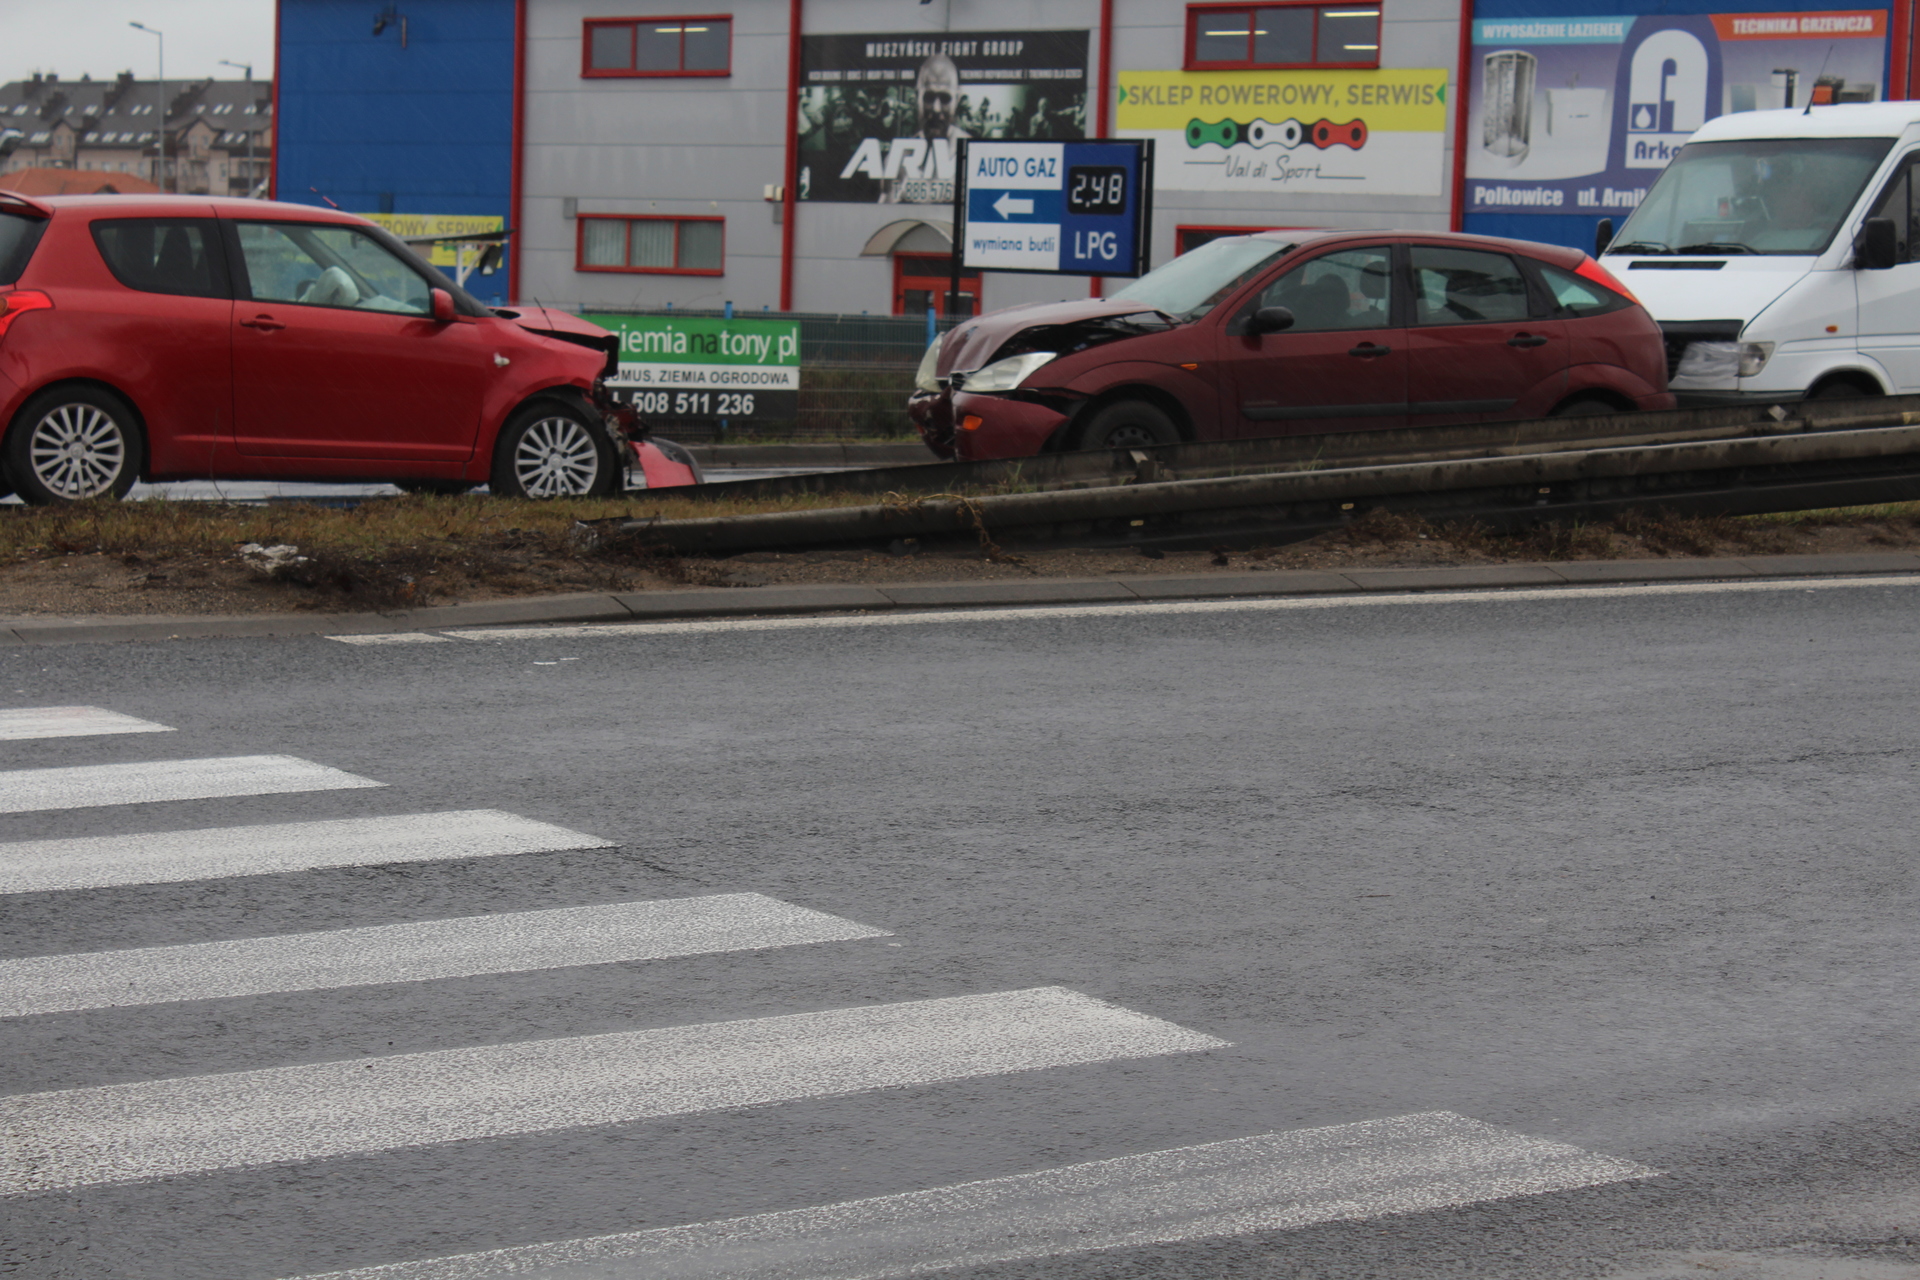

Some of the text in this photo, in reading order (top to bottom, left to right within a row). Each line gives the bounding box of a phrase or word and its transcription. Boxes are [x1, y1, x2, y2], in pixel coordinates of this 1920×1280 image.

[1733, 15, 1873, 34] TECHNIKA GRZEWCZA
[941, 41, 978, 56] FIGHT
[982, 40, 1024, 56] GROUP
[1128, 84, 1434, 107] SKLEP ROWEROWY, SERWIS
[977, 157, 1056, 177] AUTO GAZ
[1224, 154, 1322, 184] Val di Sport
[1474, 186, 1564, 206] Polkowice
[1577, 188, 1599, 207] ul.
[973, 237, 1055, 254] wymiana butli
[1075, 231, 1118, 260] LPG
[610, 324, 798, 363] iemianatony.pl
[659, 370, 706, 383] ZIEMIA
[709, 371, 790, 384] OGRODOWA
[632, 392, 669, 413] 508
[675, 393, 710, 413] 511
[716, 394, 755, 415] 236
